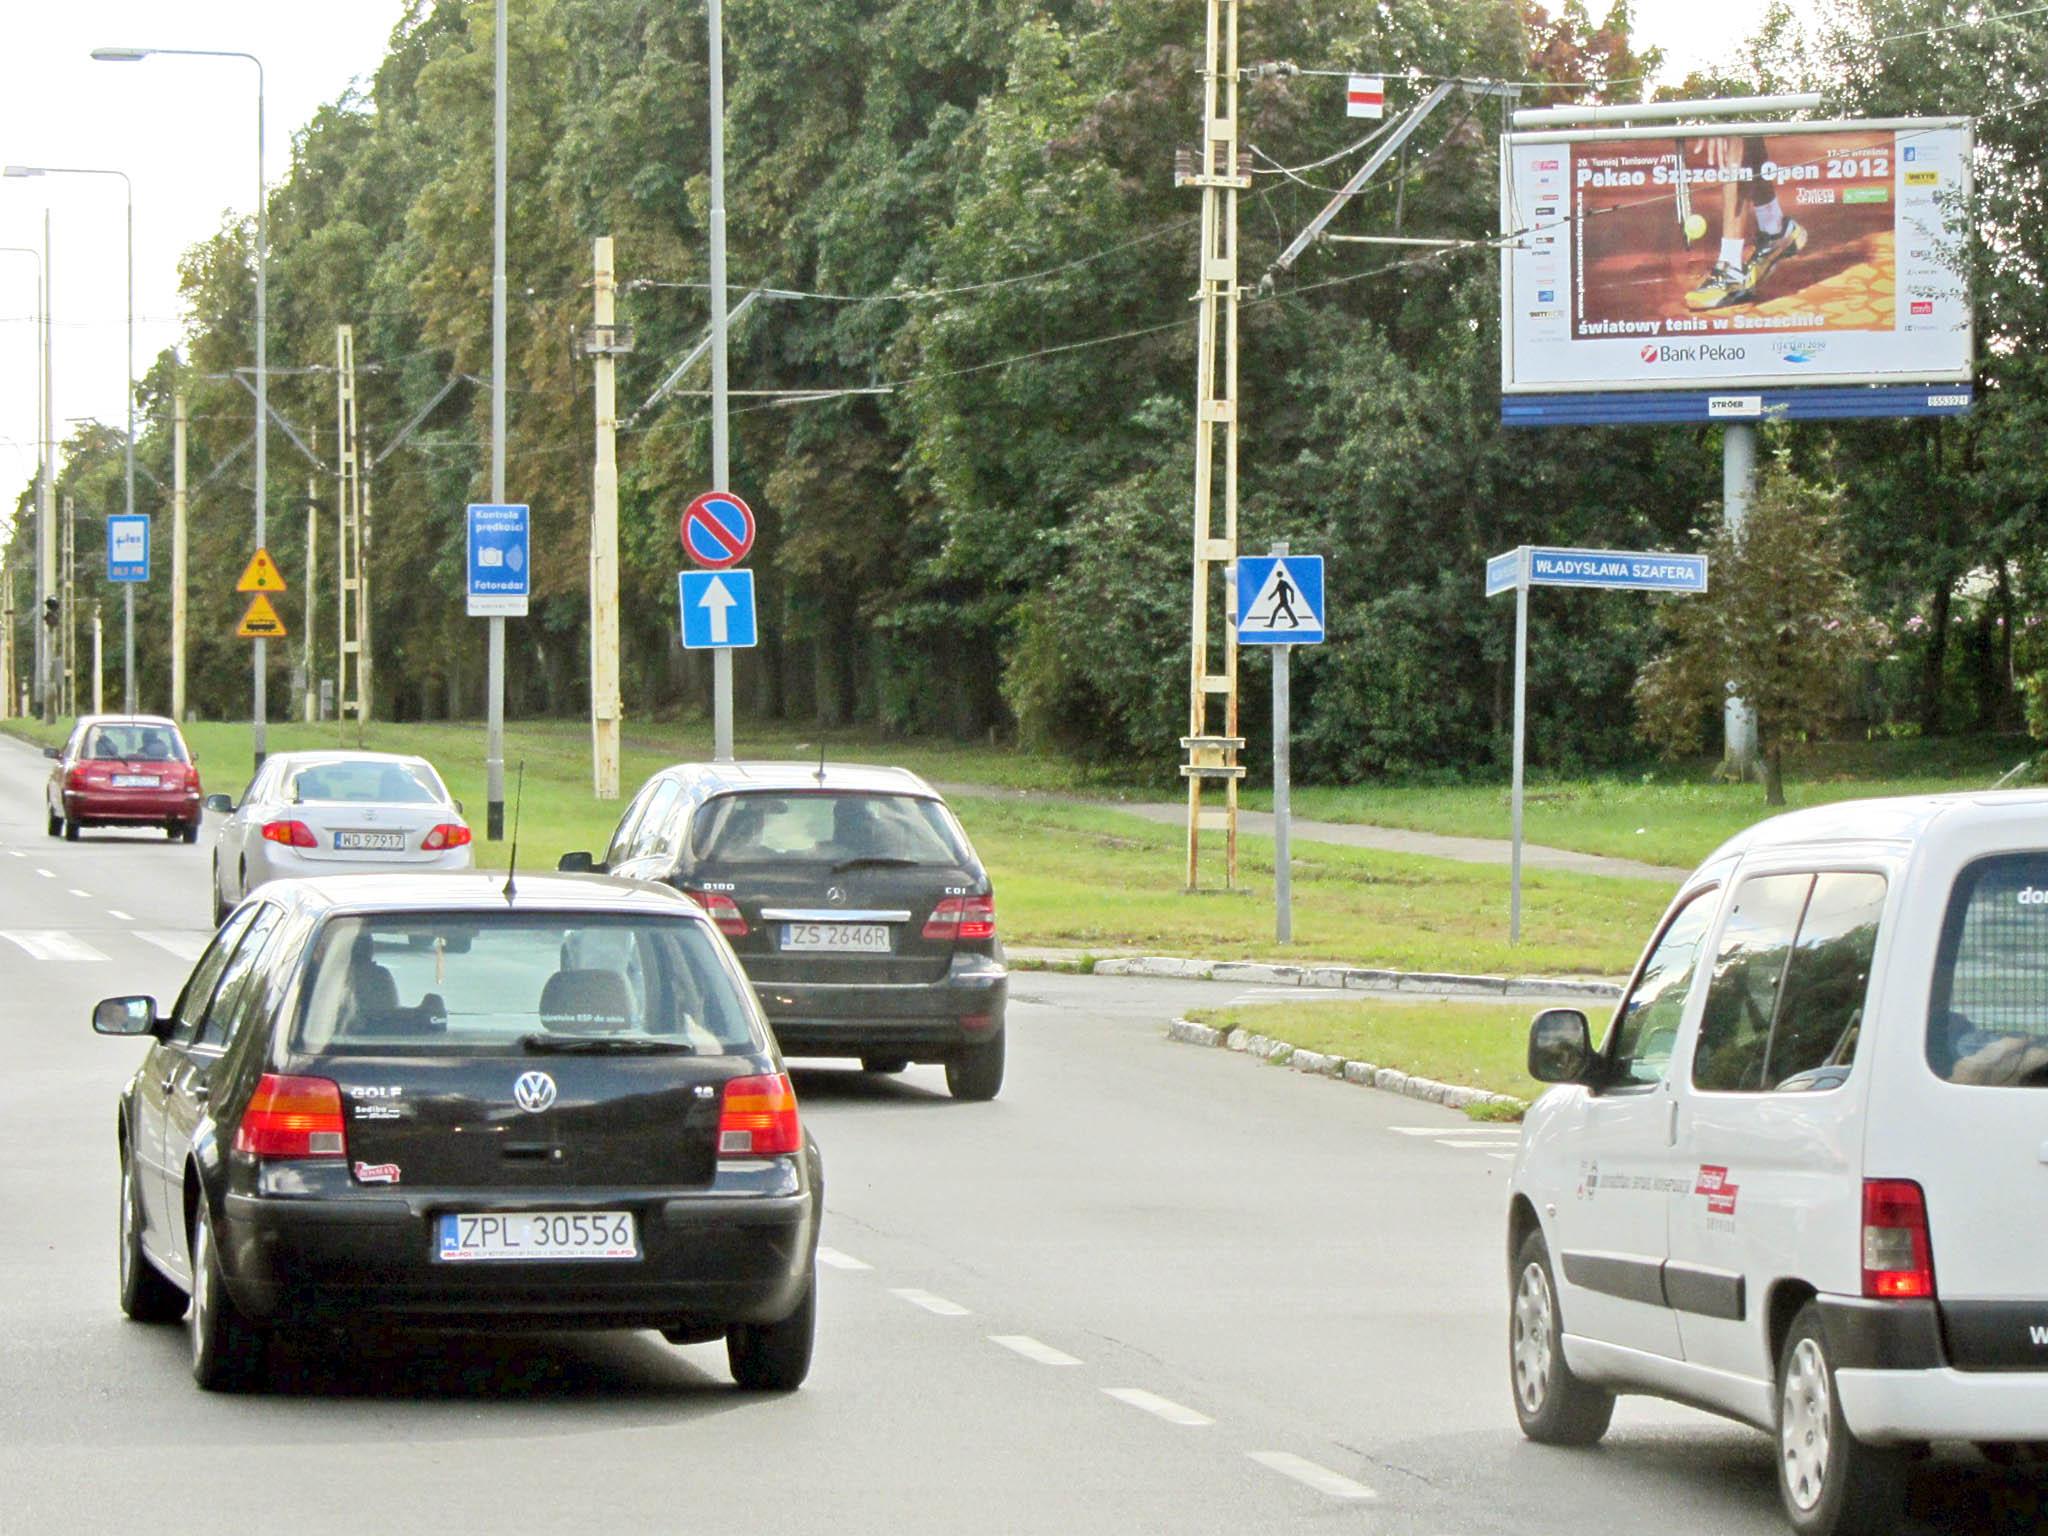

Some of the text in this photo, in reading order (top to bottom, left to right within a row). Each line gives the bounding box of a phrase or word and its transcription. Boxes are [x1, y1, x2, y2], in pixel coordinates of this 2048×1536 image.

[1577, 158, 1889, 188] Pekao Szczecin Open 2012
[1578, 312, 1825, 336] światowy tenis w Szczecinie
[1660, 342, 1746, 362] Bank Pekao
[475, 510, 519, 520] Kontrola
[475, 523, 524, 534] prędkości
[1536, 559, 1630, 577] WŁADYSŁAWA
[1632, 564, 1696, 581] SZAFERA
[475, 580, 524, 590] Fotoradar
[343, 834, 403, 848] WD 97917
[793, 925, 886, 946] ZS 2646R
[351, 1086, 402, 1099] GOLF
[461, 1215, 629, 1248] ZPL 30556
